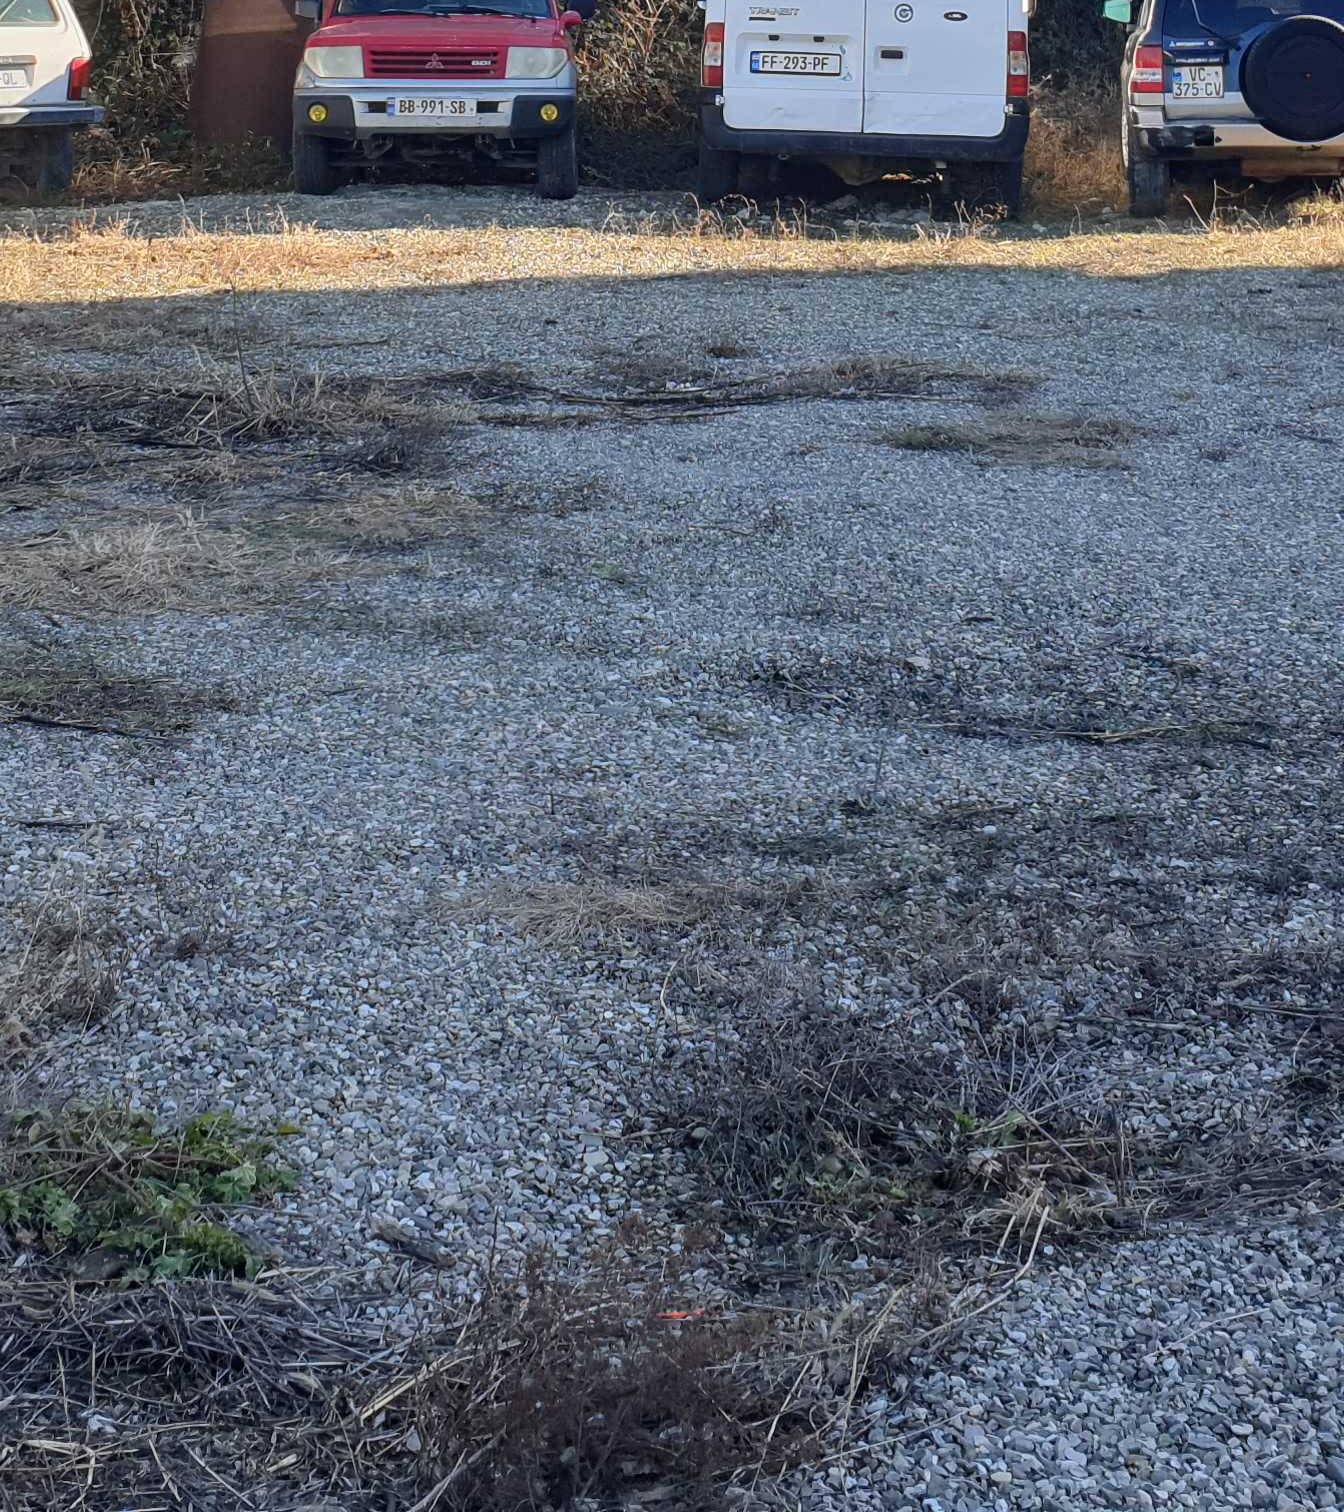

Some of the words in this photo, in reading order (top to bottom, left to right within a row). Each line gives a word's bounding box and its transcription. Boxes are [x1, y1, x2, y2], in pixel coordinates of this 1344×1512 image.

[761, 55, 829, 70] FF-293-PF
[1175, 82, 1222, 97] 375-CV
[399, 100, 467, 114] BB-991-SB
